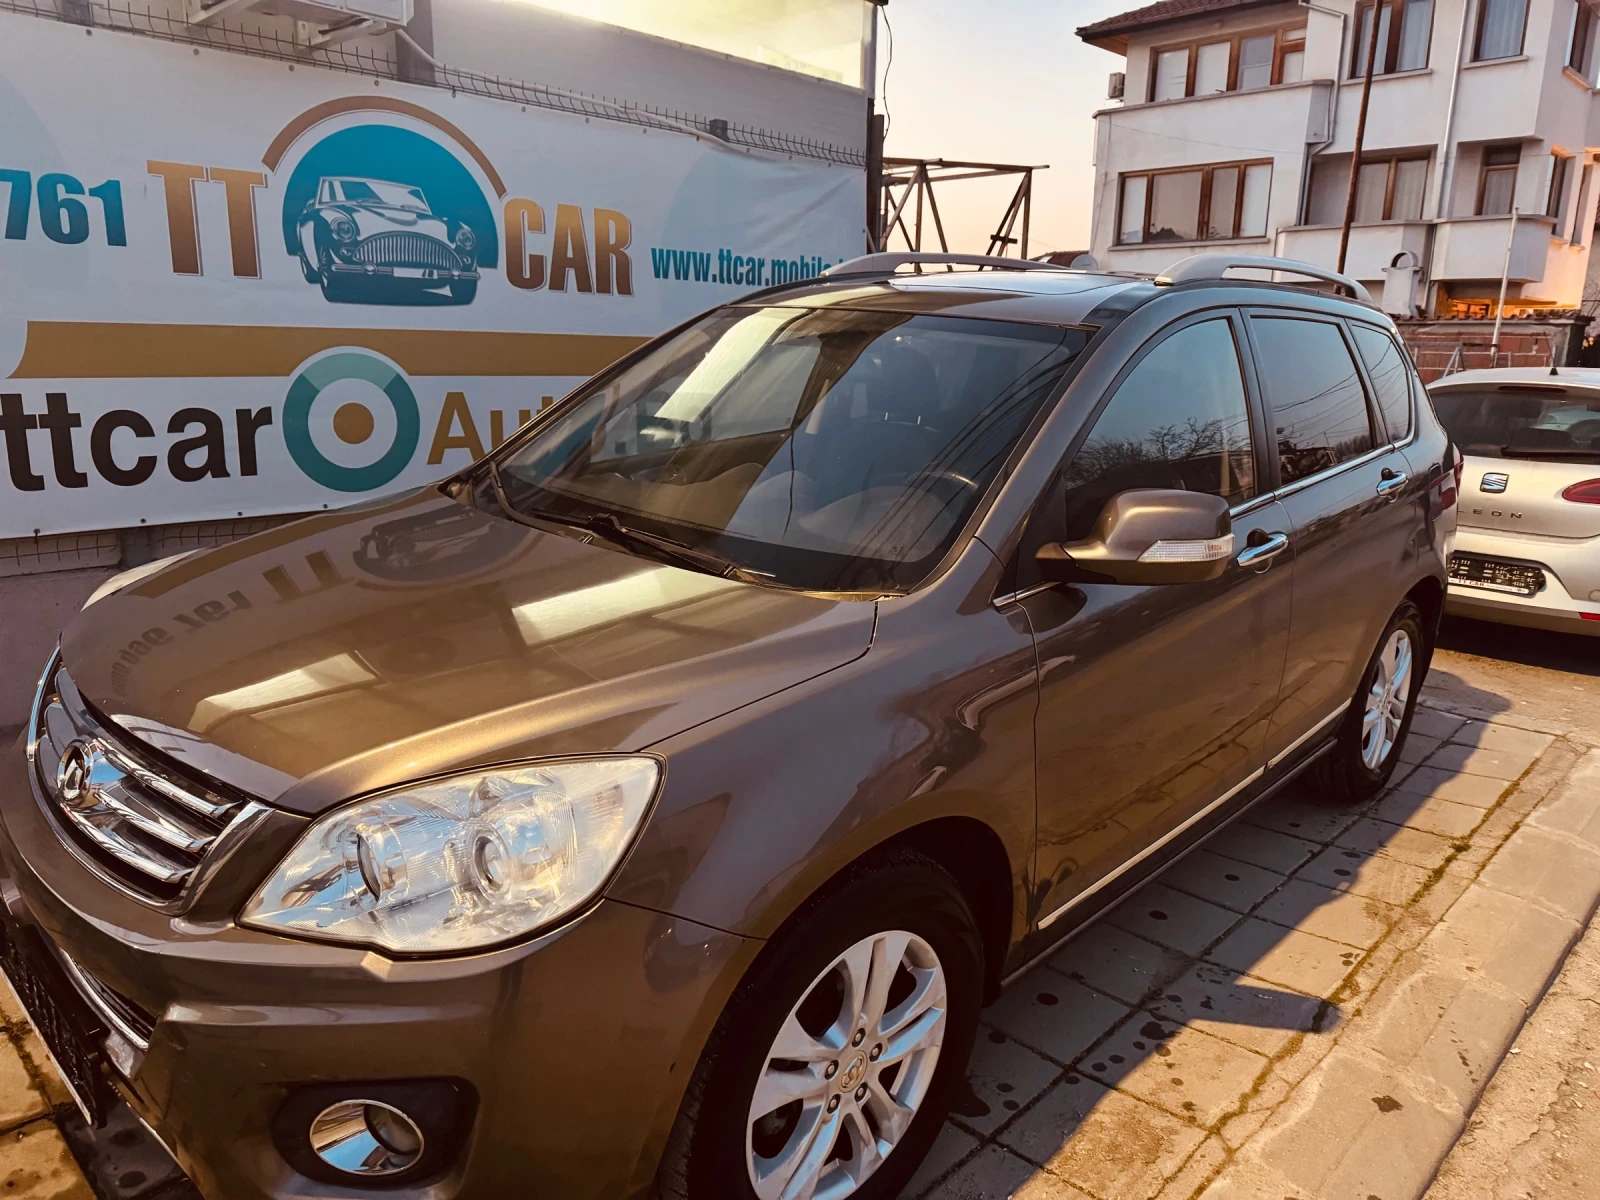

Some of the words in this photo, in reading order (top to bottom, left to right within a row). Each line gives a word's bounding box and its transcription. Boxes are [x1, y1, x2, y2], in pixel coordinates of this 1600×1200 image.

[0, 168, 127, 247] 761
[146, 159, 268, 280] TT
[503, 197, 635, 298] CAR
[650, 247, 844, 287] www.ttcar.mobil
[0, 391, 273, 492] ttcar
